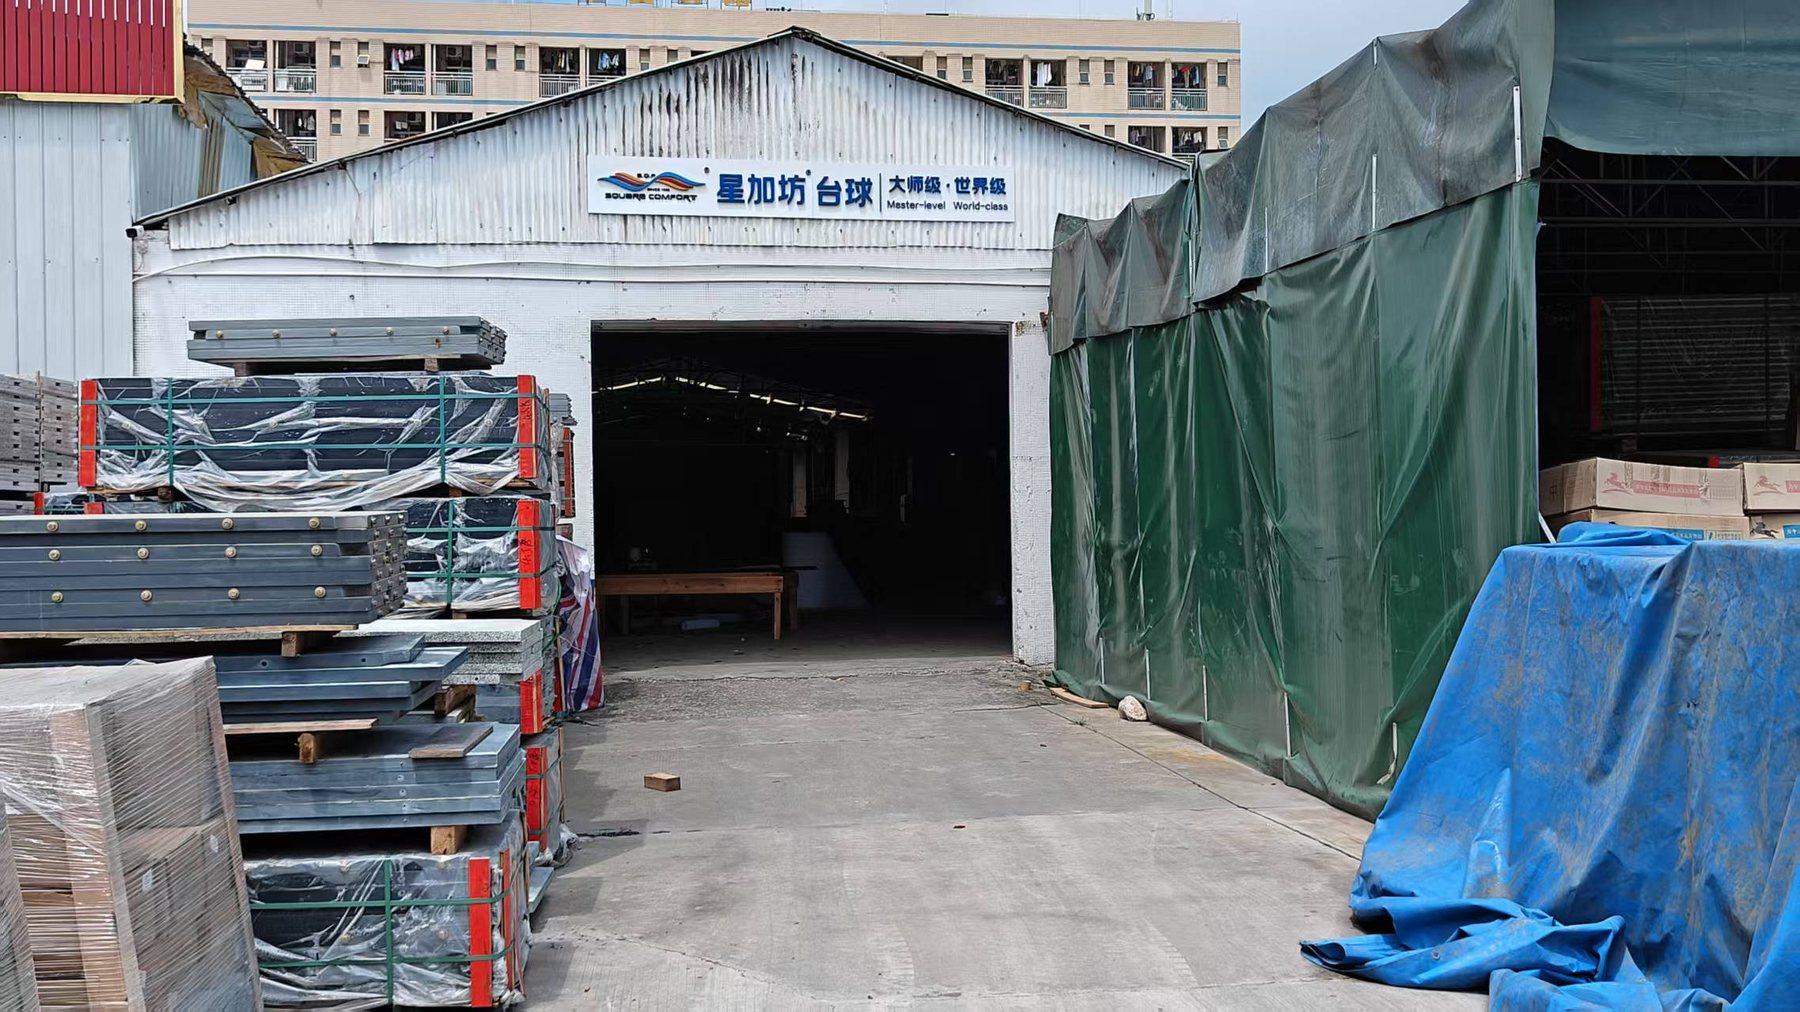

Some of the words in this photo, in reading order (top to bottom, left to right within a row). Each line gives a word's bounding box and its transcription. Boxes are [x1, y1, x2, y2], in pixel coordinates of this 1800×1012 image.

[648, 194, 698, 202] COMFORT
[887, 200, 946, 210] Master-level
[953, 201, 1009, 211] World-class
